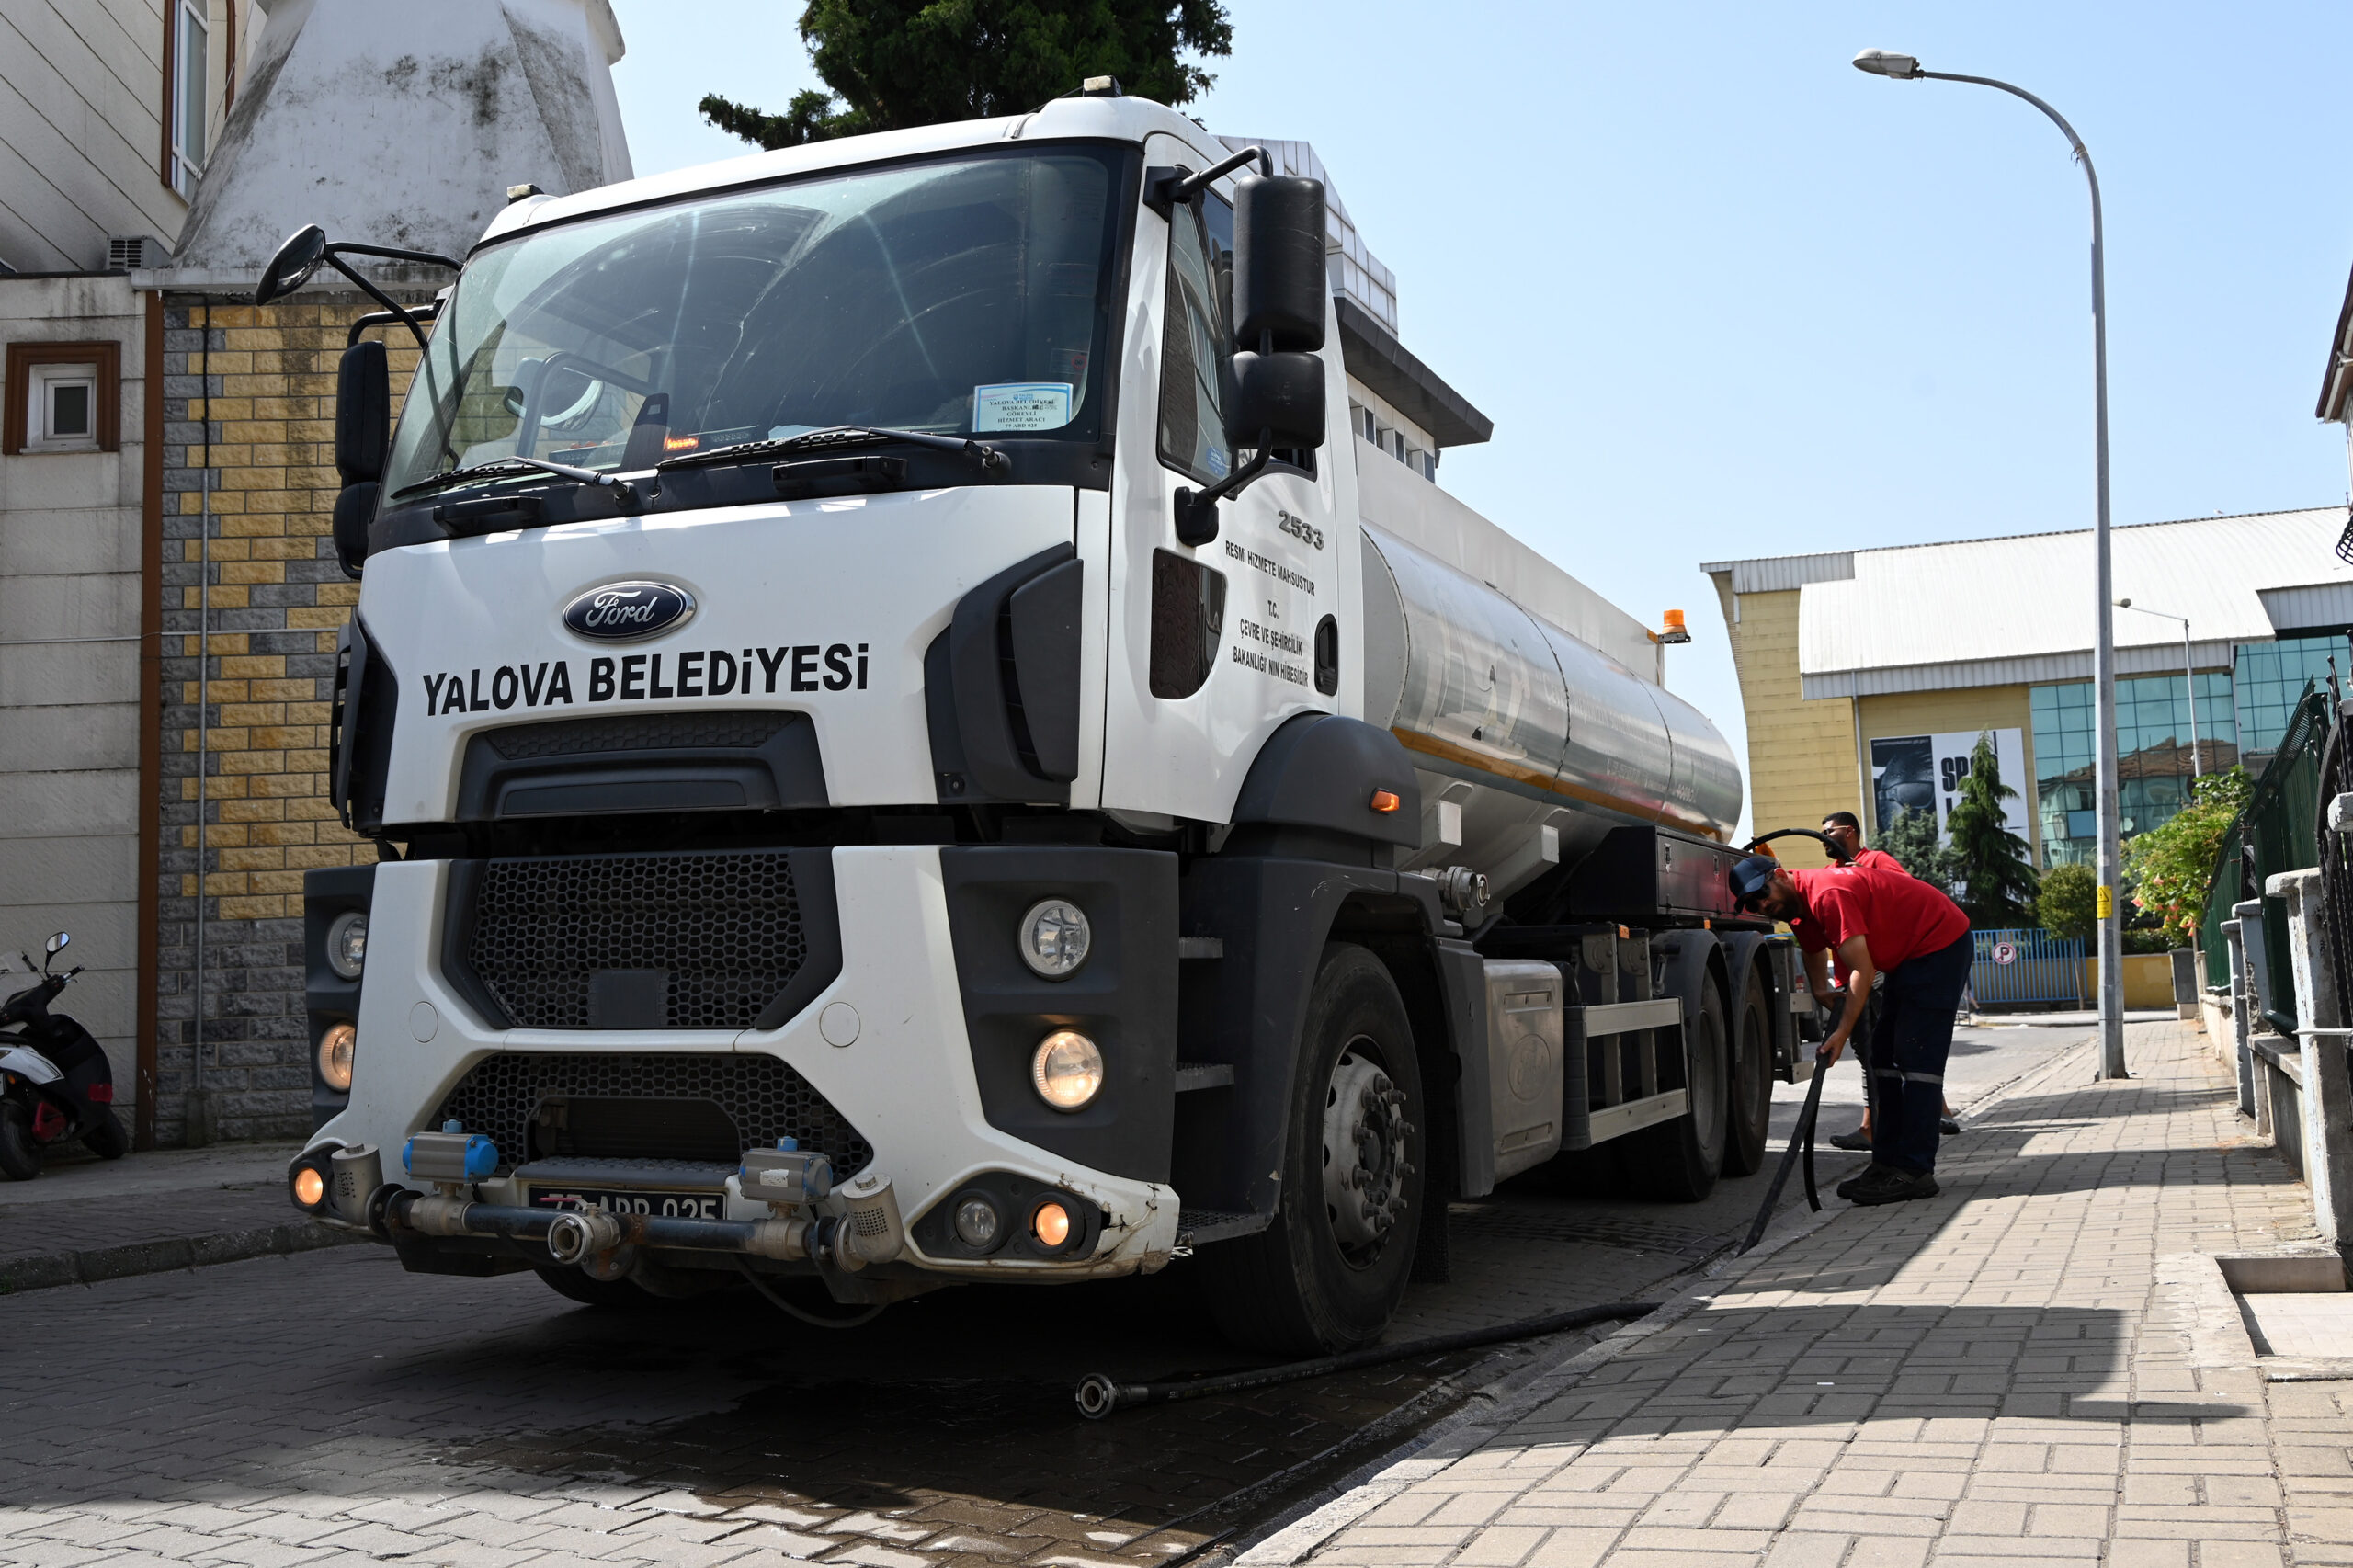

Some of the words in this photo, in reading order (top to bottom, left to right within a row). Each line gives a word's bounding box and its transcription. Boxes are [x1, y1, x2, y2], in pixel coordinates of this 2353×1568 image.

[1279, 510, 1324, 551] 2533
[1278, 564, 1315, 596] MAHSUSTUR
[585, 590, 655, 628] Ford
[1267, 600, 1279, 619] T.C.
[1240, 618, 1260, 641] ÇEVRE
[1261, 626, 1270, 644] VE
[423, 660, 573, 716] YALOVA
